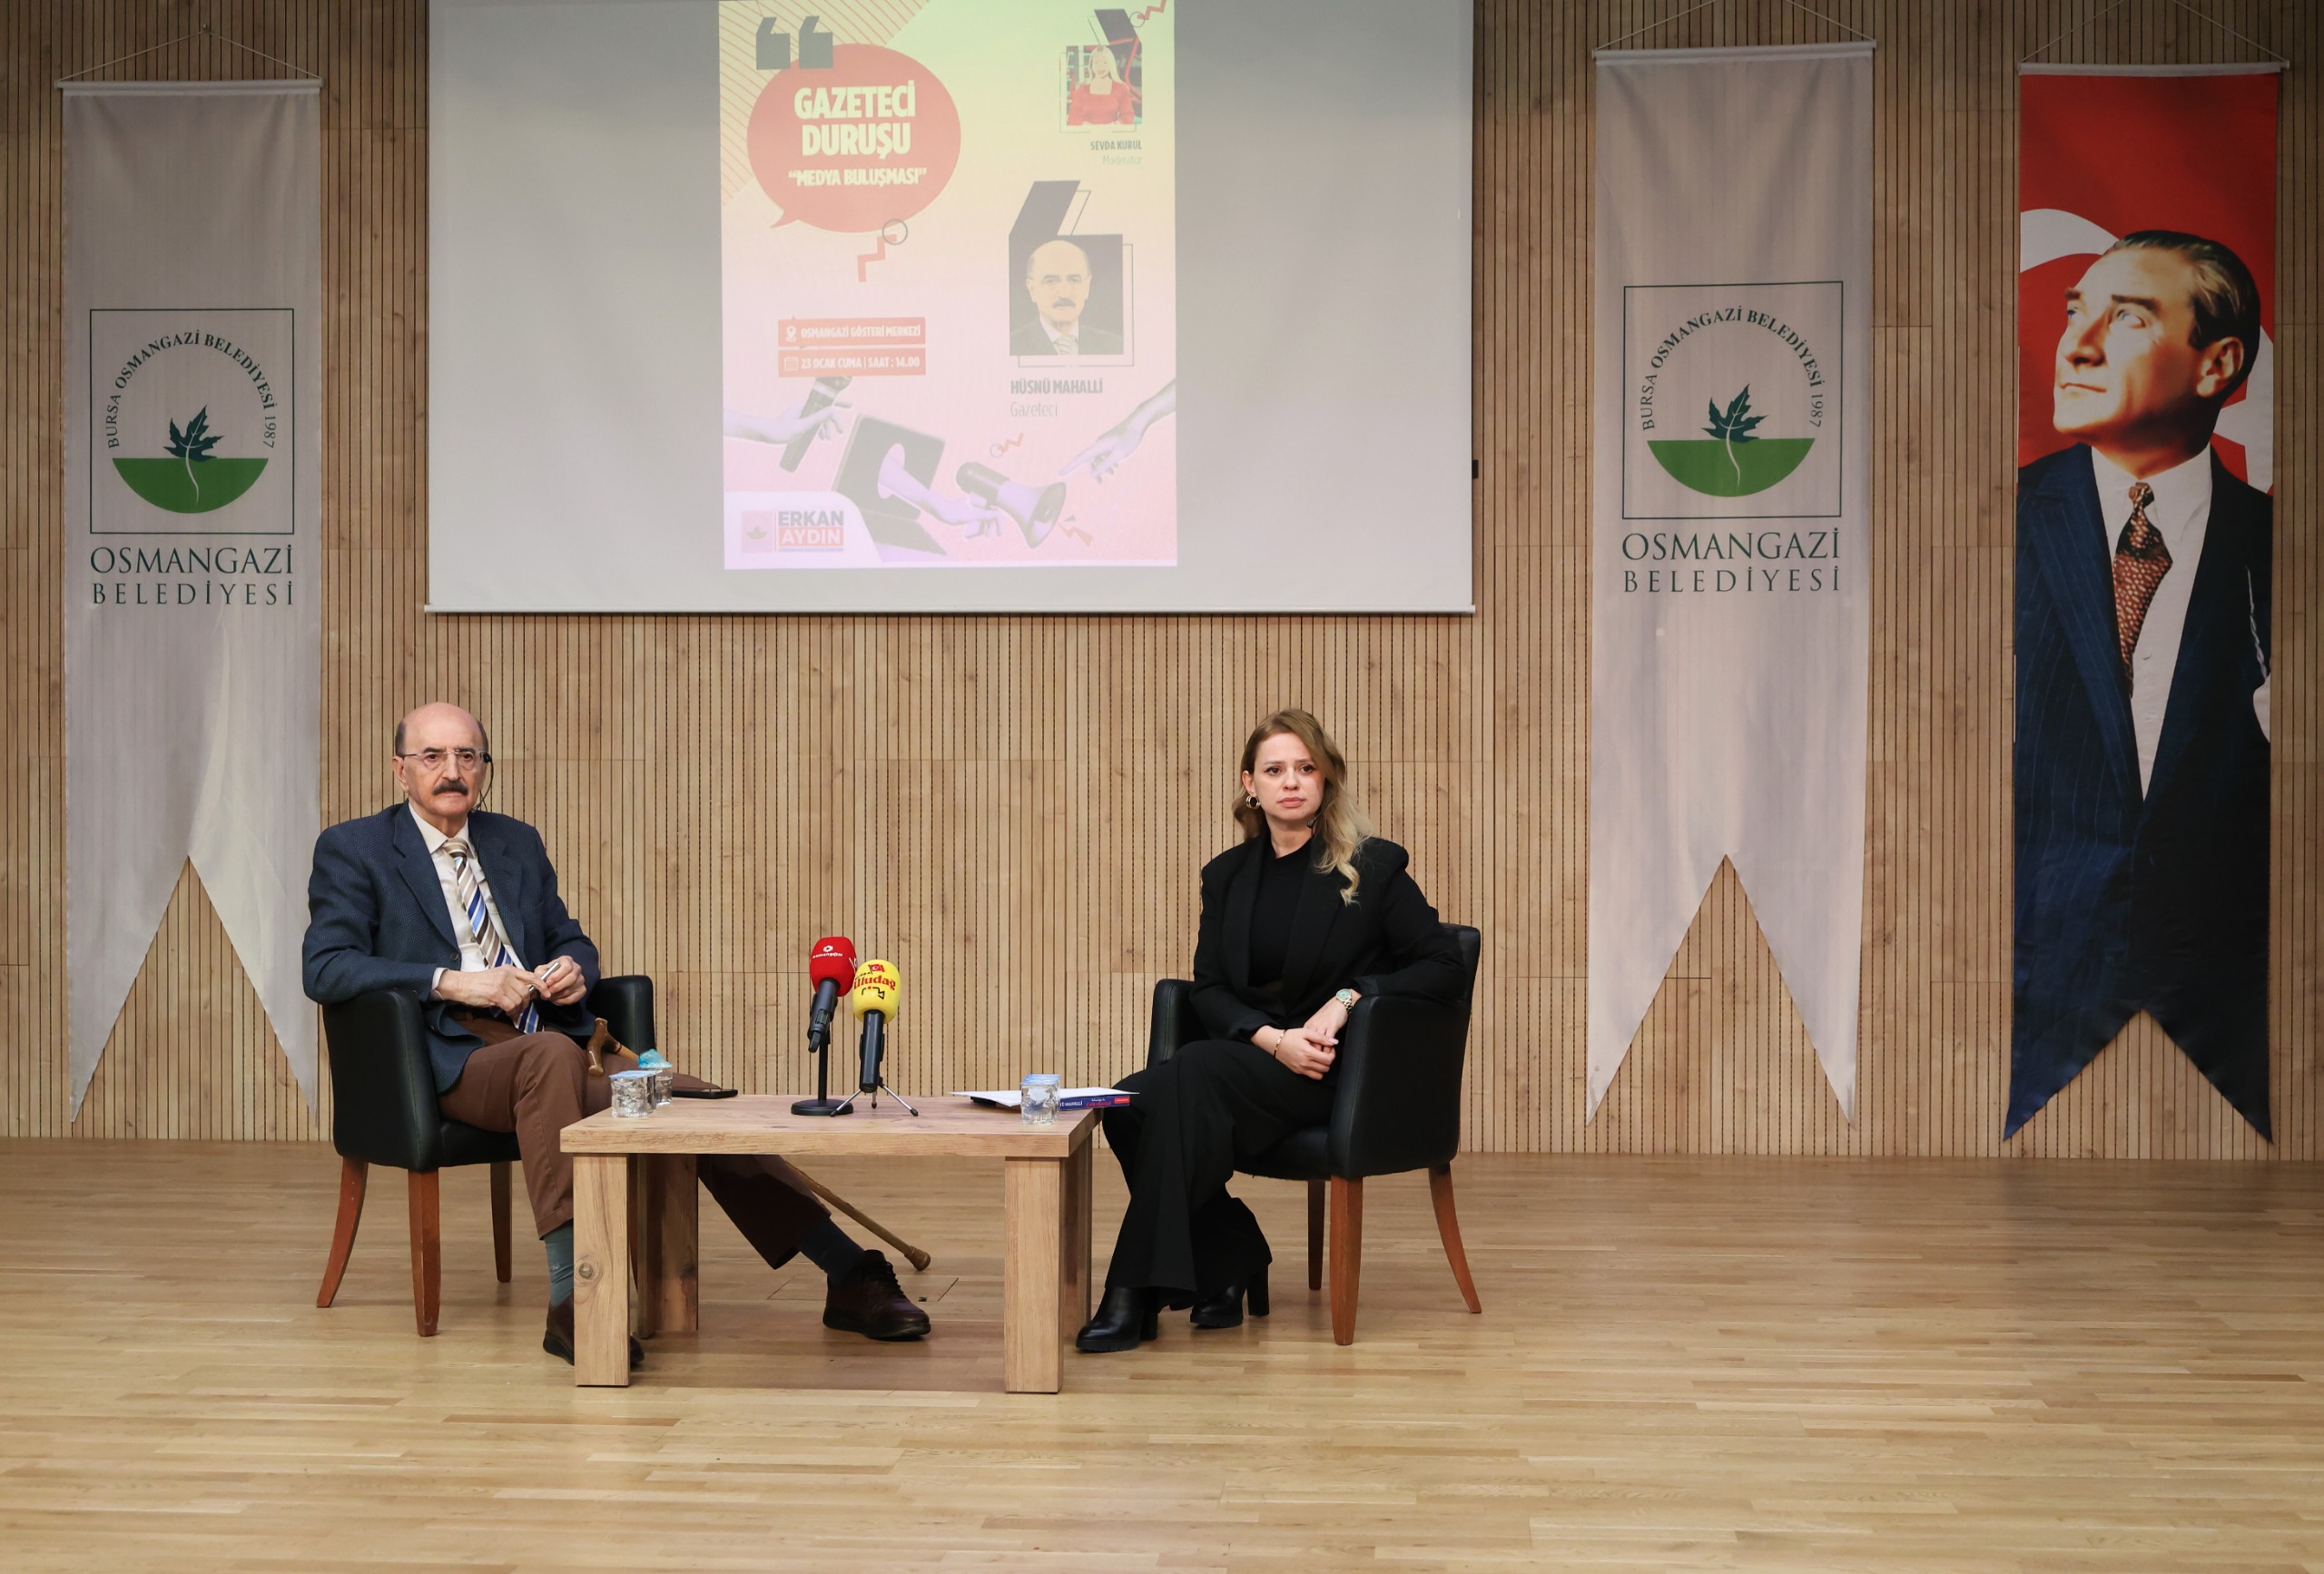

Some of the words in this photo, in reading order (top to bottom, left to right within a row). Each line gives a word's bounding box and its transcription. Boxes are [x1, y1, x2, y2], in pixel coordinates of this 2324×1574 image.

[793, 79, 916, 120] GAZETECİ
[802, 122, 911, 160] DURUŞU
[1090, 140, 1116, 151] SEVDA
[1117, 140, 1143, 150] KURUL
[801, 325, 849, 339] OSMANGAZİ
[851, 324, 885, 338] GÖSTERİ
[885, 324, 921, 337] MERKEZİ
[812, 358, 836, 369] OCAK
[838, 357, 862, 369] CUMA
[1640, 373, 1659, 431] BURSA
[1650, 305, 1743, 369] OSMANGAZİ
[1747, 310, 1826, 388] BELEDİYESİ
[1809, 393, 1824, 428] 1987
[105, 393, 122, 449] BURSA
[114, 330, 201, 389] OSMANGAZİ
[204, 333, 278, 409] BELEDİYESİ
[262, 416, 277, 448] 1987
[1010, 377, 1050, 394] HÜSNÜ
[1052, 377, 1104, 394] MAHALLİ
[1010, 401, 1059, 418] Gazeteci
[778, 510, 844, 526] ERKAN
[781, 528, 841, 545] AYDIN
[1621, 526, 1841, 561] OSMANGAZİ
[90, 544, 292, 574] OSMANGAZİ
[93, 579, 293, 605] BELEDİYESİ
[1623, 566, 1840, 593] BELEDİYESİ
